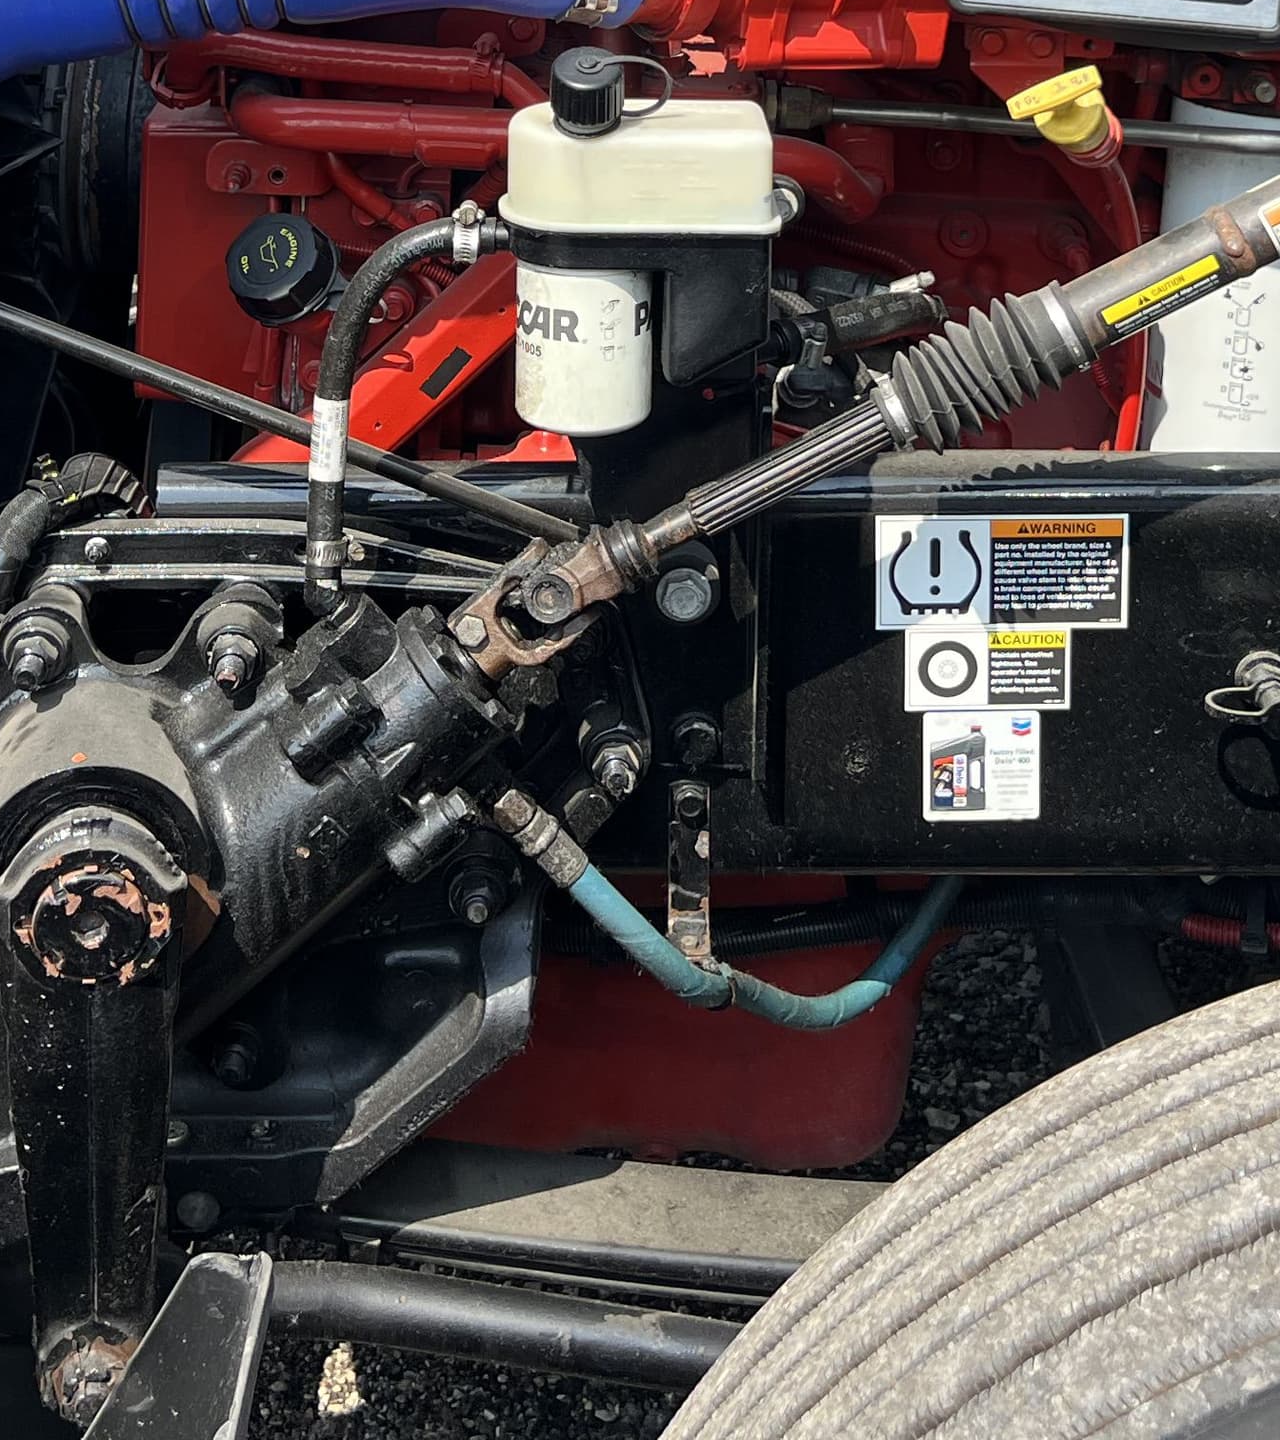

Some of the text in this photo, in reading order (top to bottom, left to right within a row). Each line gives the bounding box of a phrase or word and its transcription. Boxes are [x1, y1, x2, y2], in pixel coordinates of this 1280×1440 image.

[280, 227, 298, 268] ENGINE
[240, 255, 250, 274] OIL
[1151, 273, 1185, 297] CAUTION
[516, 299, 652, 343] CAR P
[516, 335, 542, 357] -1005
[1028, 522, 1096, 534] WARNING
[994, 551, 1010, 559] part
[1057, 551, 1065, 559] by
[1068, 551, 1080, 559] the
[1081, 551, 1108, 559] original
[994, 602, 1009, 610] may
[1028, 602, 1036, 610] to
[1002, 634, 1064, 645] CAUTION
